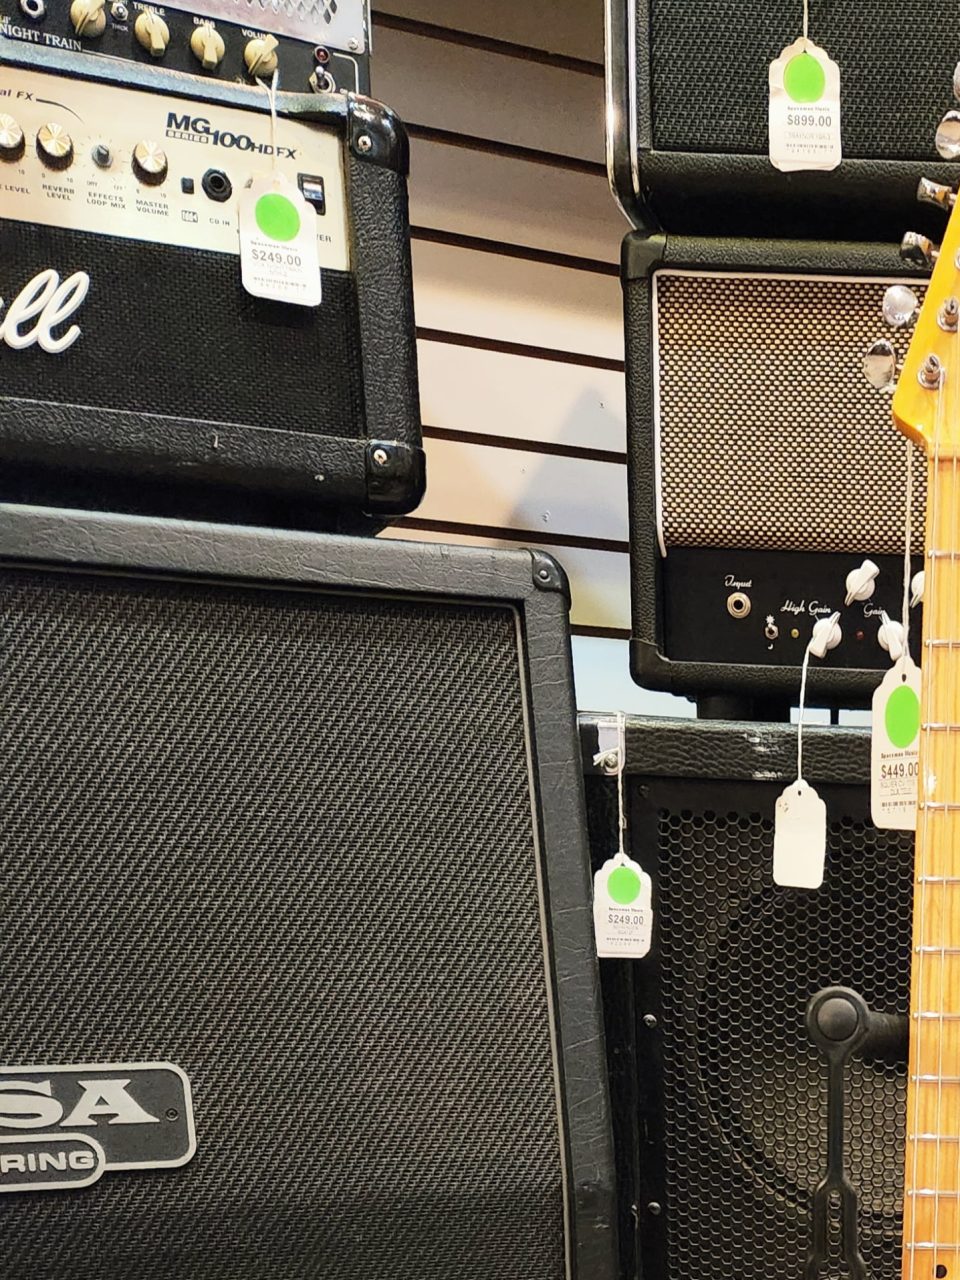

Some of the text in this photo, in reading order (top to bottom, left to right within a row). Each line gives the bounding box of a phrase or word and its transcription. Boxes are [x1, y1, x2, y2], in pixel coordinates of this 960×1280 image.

[0, 23, 82, 51] NIGHT TRAIN
[241, 28, 271, 41] VOLU
[16, 91, 34, 101] FX
[787, 114, 832, 127] $899.00
[5, 184, 31, 195] LEVEL
[42, 184, 75, 194] REVERB
[46, 191, 71, 201] LEVEL
[86, 198, 108, 206] LOOP
[88, 191, 124, 202] EFFECTS
[136, 199, 169, 209] MASTER
[136, 206, 169, 216] VOLUME
[251, 249, 302, 267] $249.00
[0, 268, 90, 354] ll
[780, 599, 832, 616] High Gain
[881, 762, 919, 779] $449.00
[608, 913, 644, 925] $249.00
[0, 1150, 95, 1173] RING
